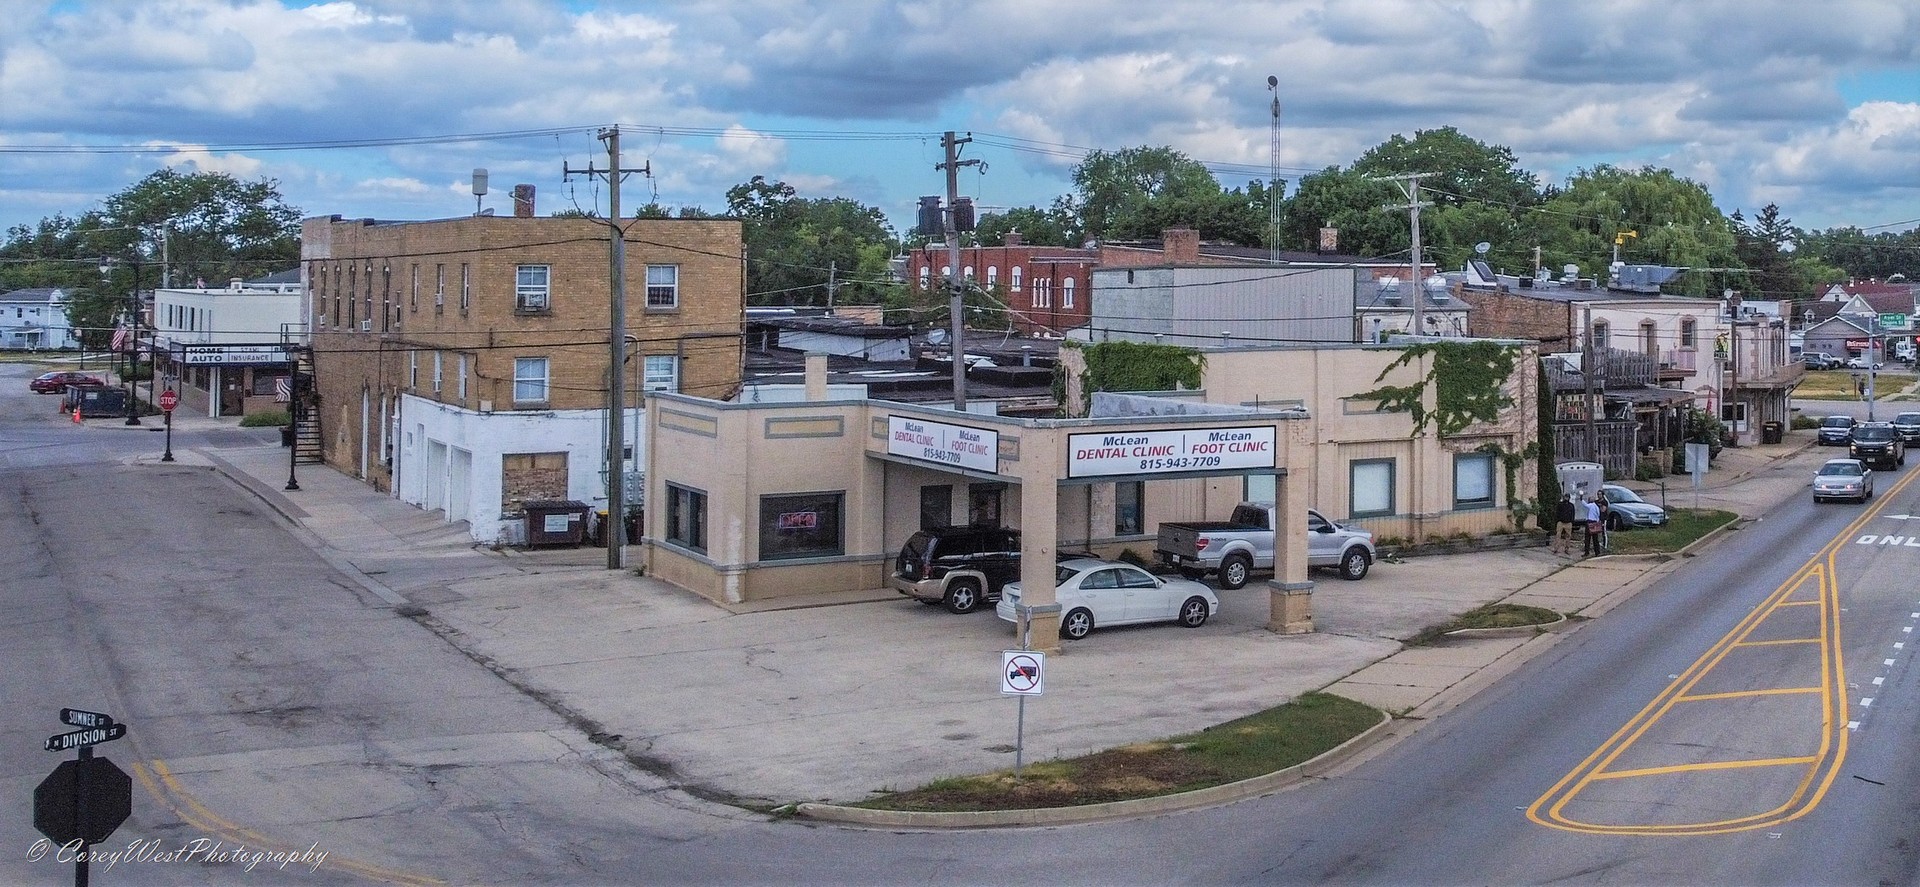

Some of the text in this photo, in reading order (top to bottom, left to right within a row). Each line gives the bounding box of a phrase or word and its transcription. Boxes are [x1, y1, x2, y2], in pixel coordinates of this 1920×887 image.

[230, 354, 269, 362] INSURANCE
[160, 396, 177, 405] STOP
[905, 421, 924, 434] McLean
[894, 430, 934, 447] DENTAL CLINIC
[959, 430, 980, 442] McLean
[1102, 436, 1149, 447] McLean
[1208, 431, 1252, 442] McLean
[923, 447, 961, 463] 815-943-7709
[951, 440, 988, 456] FOOT CLINIC
[1076, 445, 1175, 460] DENTAL CLINIC
[1191, 441, 1268, 455] FOOT CLINIC
[1140, 455, 1221, 470] 815-943-7709
[1856, 535, 1920, 547] ONL
[68, 710, 105, 727] SUMNER ST
[62, 729, 106, 748] DIVISION
[109, 728, 118, 737] ST
